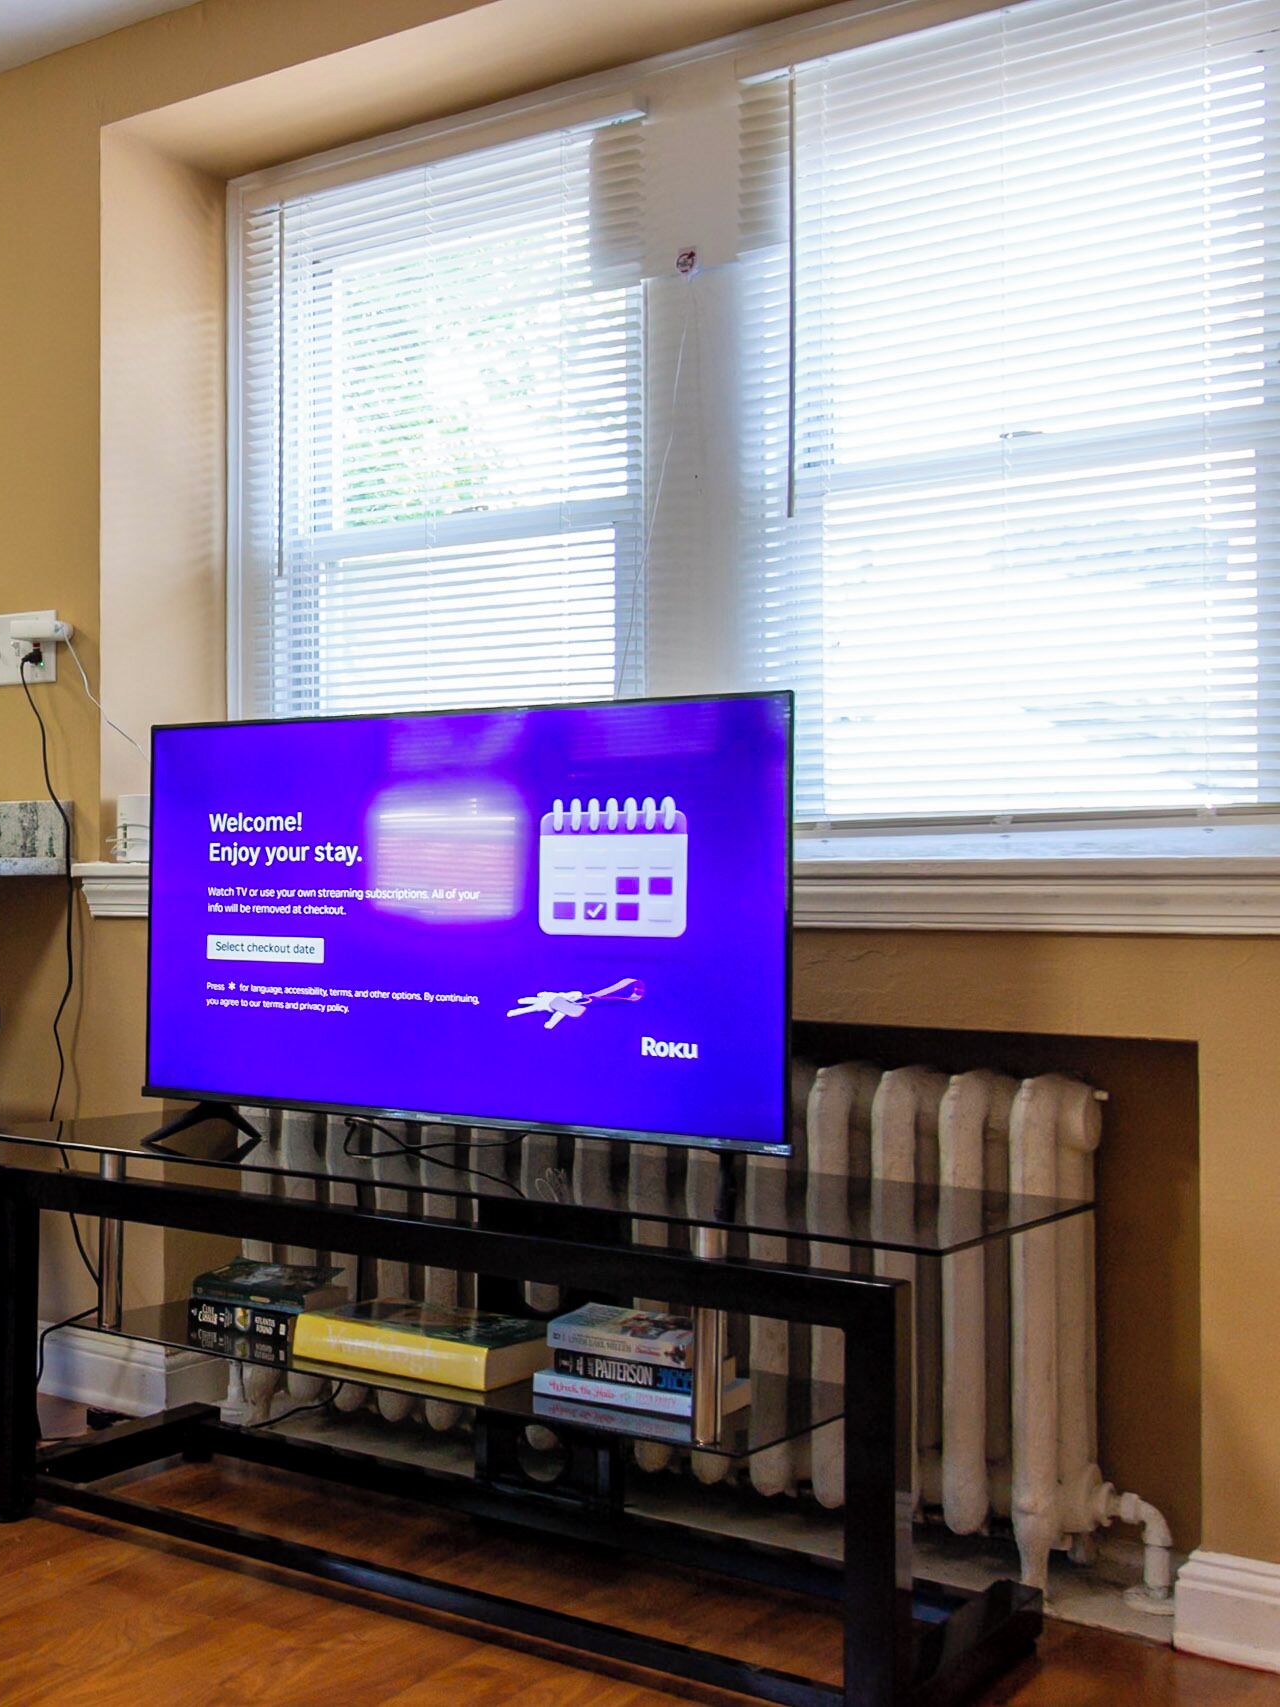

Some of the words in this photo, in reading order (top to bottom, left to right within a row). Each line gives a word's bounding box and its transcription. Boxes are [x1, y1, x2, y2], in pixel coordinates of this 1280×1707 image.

[208, 812, 303, 833] Welcome!
[208, 842, 261, 866] Enjoy
[265, 843, 310, 866] your
[314, 842, 363, 867] stay.
[207, 886, 235, 898] Watch
[235, 886, 248, 898] TV
[249, 888, 259, 898] or
[259, 888, 275, 899] use
[276, 888, 296, 900] your
[297, 889, 317, 899] own
[317, 887, 364, 900] streaming
[365, 888, 430, 901] subscriptions.
[431, 889, 445, 900] All
[445, 889, 456, 900] of
[456, 890, 481, 902] your
[207, 902, 224, 913] info
[225, 902, 239, 914] will
[239, 903, 251, 914] be
[252, 903, 291, 915] removed
[292, 904, 302, 915] at
[303, 903, 347, 916] checkout.
[215, 941, 245, 953] Select
[246, 942, 291, 955] checkout
[293, 943, 316, 955] date
[206, 982, 225, 991] Press
[239, 982, 249, 992] for
[250, 983, 283, 995] language,
[284, 985, 328, 998] accessibility,
[329, 987, 353, 998] terms,
[354, 988, 368, 998] and
[369, 989, 390, 999] other
[391, 990, 422, 1002] options.
[423, 991, 435, 1003] By
[435, 992, 481, 1005] continuing,
[206, 998, 220, 1007] you
[220, 998, 240, 1008] agree
[240, 998, 248, 1007] to
[249, 999, 261, 1008] our
[262, 999, 284, 1009] terms
[285, 1000, 298, 1010] and
[299, 1001, 325, 1012] privacy
[326, 1002, 349, 1013] policy.
[641, 1036, 699, 1059] Roku
[595, 1358, 654, 1386] PATTERSON
